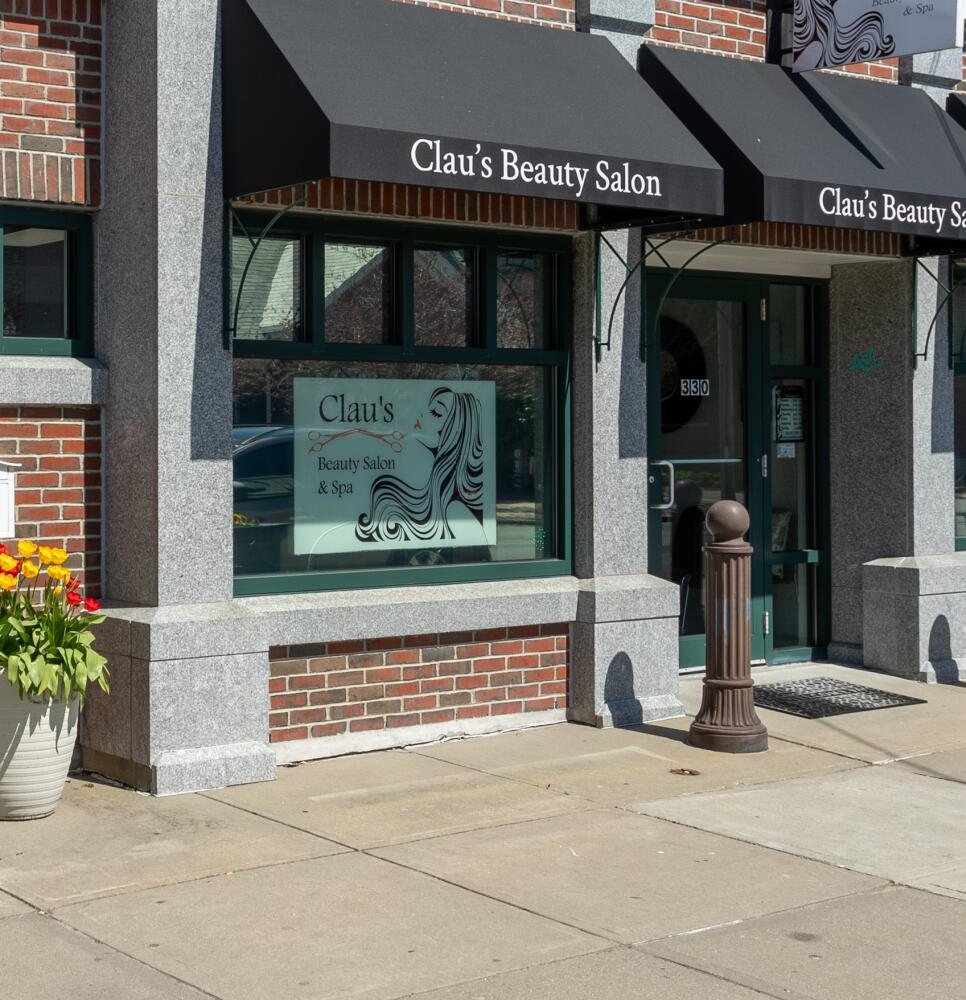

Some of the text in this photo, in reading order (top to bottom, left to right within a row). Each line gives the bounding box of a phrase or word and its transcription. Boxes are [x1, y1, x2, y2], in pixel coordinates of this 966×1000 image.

[903, 3, 934, 16] & Spa
[410, 138, 662, 197] Clau's Beauty Salon
[818, 186, 877, 219] Clau's
[882, 193, 947, 233] Beauty
[682, 380, 708, 395] 330
[319, 393, 394, 424] Clau's
[318, 456, 396, 474] Beauty Salon
[318, 480, 353, 498] & Spa
